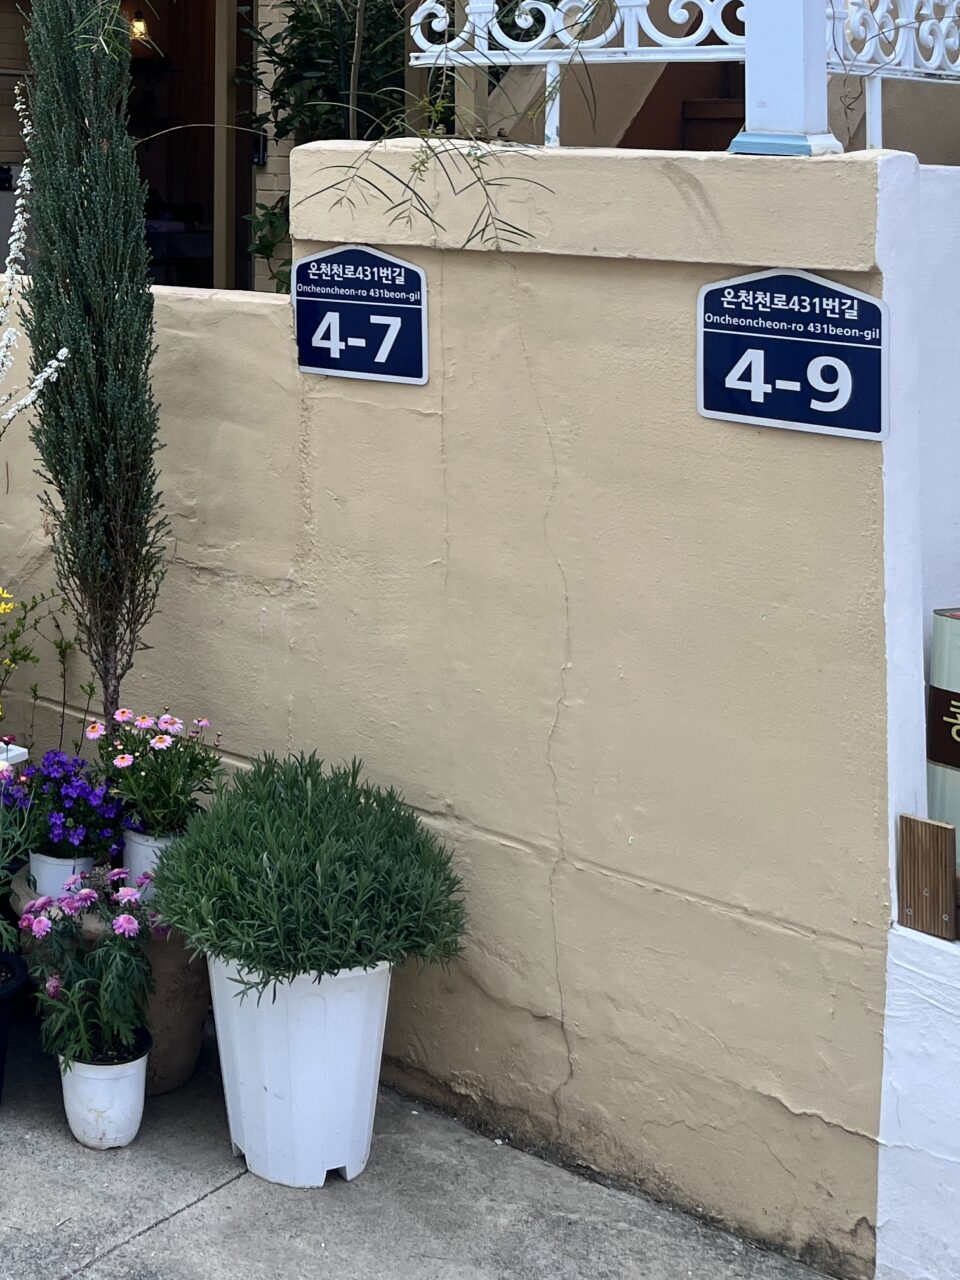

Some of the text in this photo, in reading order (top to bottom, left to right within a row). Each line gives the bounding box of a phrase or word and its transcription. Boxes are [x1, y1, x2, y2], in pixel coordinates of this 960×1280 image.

[308, 262, 405, 285] 온천천로431번길
[297, 283, 421, 302] Oncheoncheon-ro 431beon-gil
[720, 288, 859, 320] 온천천로431번길
[311, 311, 402, 363] 4-7
[704, 312, 880, 341] Oncheoncheon-ro 431beon-gil
[724, 348, 853, 412] 4-9
